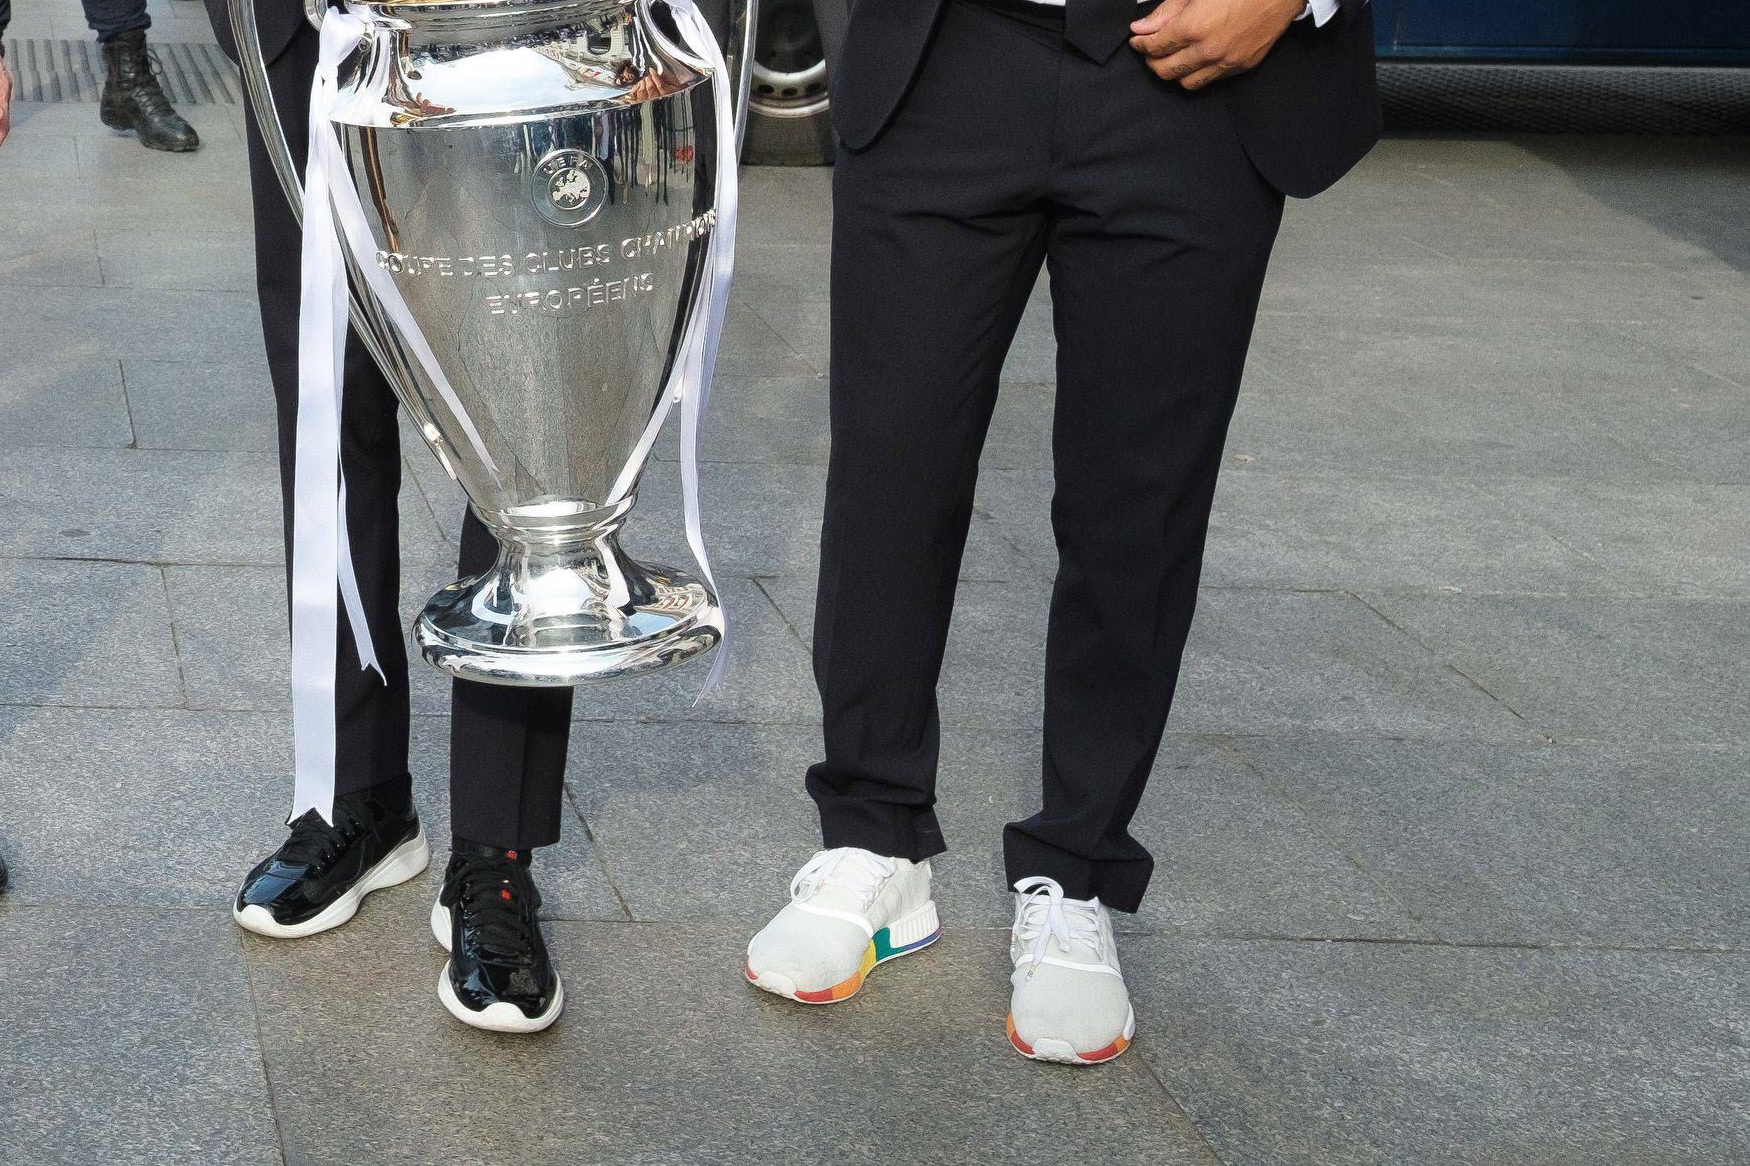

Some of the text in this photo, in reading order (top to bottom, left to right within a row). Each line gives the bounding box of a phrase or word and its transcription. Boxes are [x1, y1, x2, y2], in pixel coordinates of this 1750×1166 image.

[543, 154, 594, 175] UEFA
[376, 249, 454, 276] COUPE
[458, 253, 515, 277] DES
[525, 243, 611, 275] CLUBS
